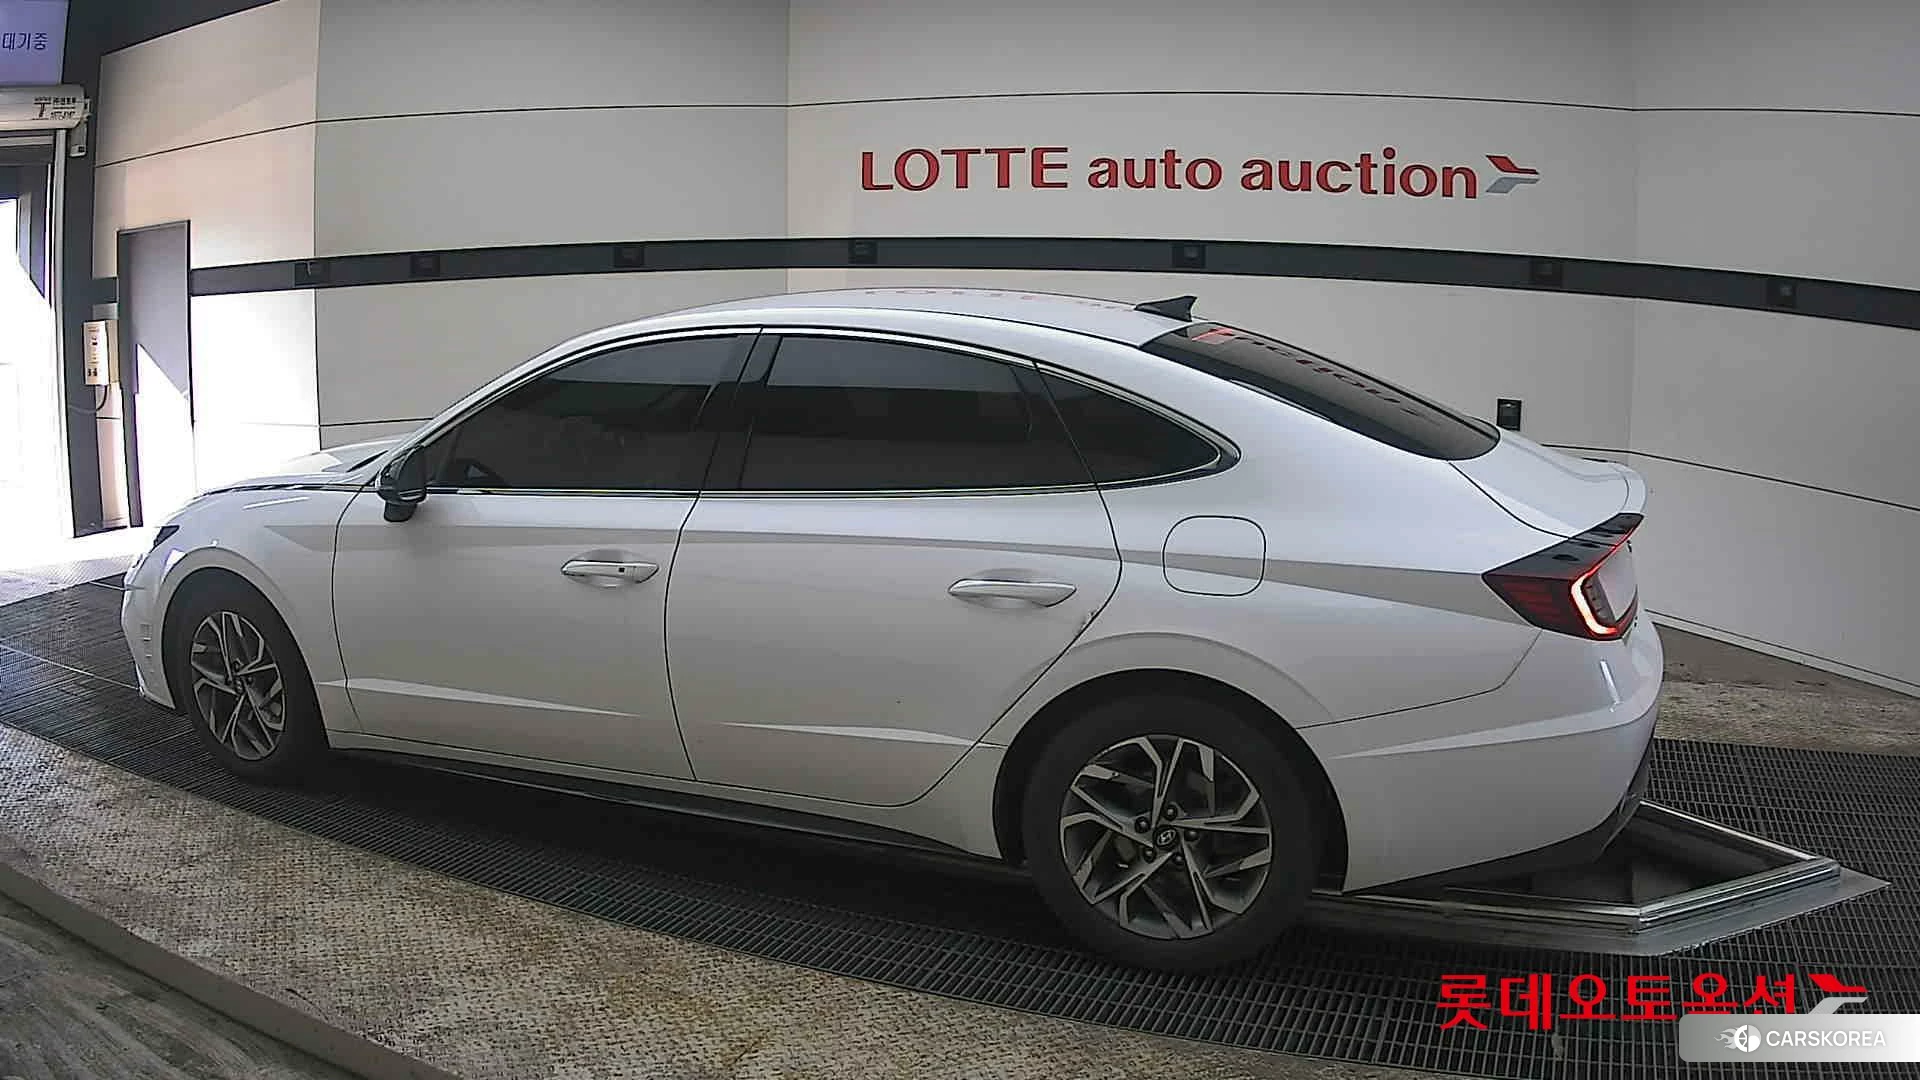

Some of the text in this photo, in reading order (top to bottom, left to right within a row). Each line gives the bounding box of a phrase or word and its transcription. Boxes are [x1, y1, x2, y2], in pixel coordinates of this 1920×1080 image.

[2, 32, 48, 51] 대기중
[861, 147, 1478, 199] LOTTE auto auction
